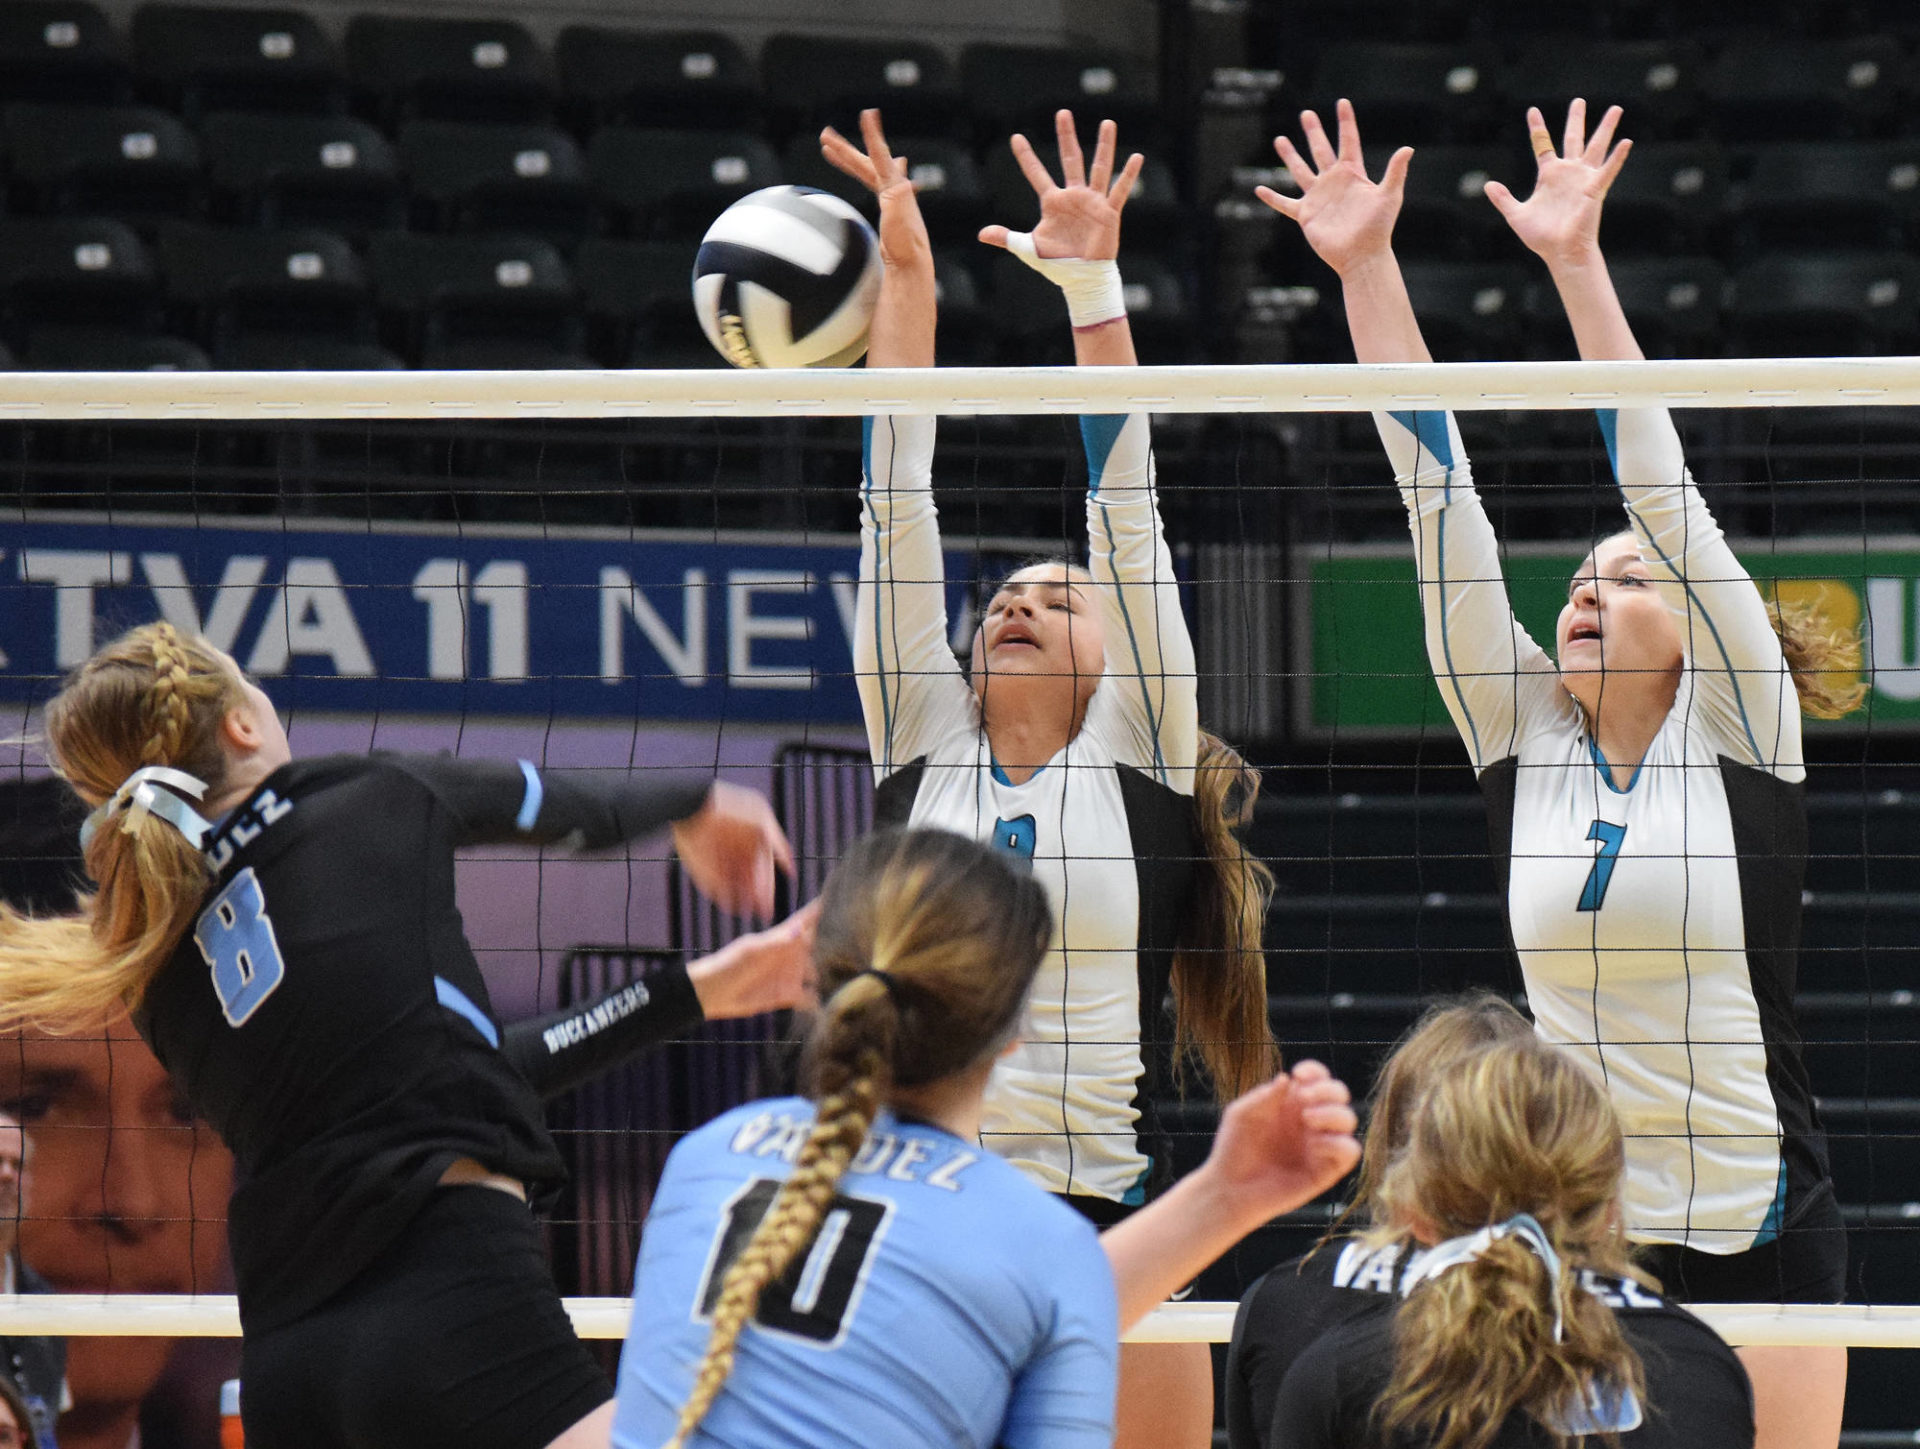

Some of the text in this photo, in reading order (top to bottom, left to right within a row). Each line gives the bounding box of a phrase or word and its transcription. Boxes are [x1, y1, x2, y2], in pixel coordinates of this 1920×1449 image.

[0, 548, 968, 690] TVA 11 NE
[1576, 819, 1628, 912] 7
[194, 866, 285, 1028] 8
[542, 979, 650, 1055] BUCCANEERS
[728, 1112, 980, 1193] VADEZ
